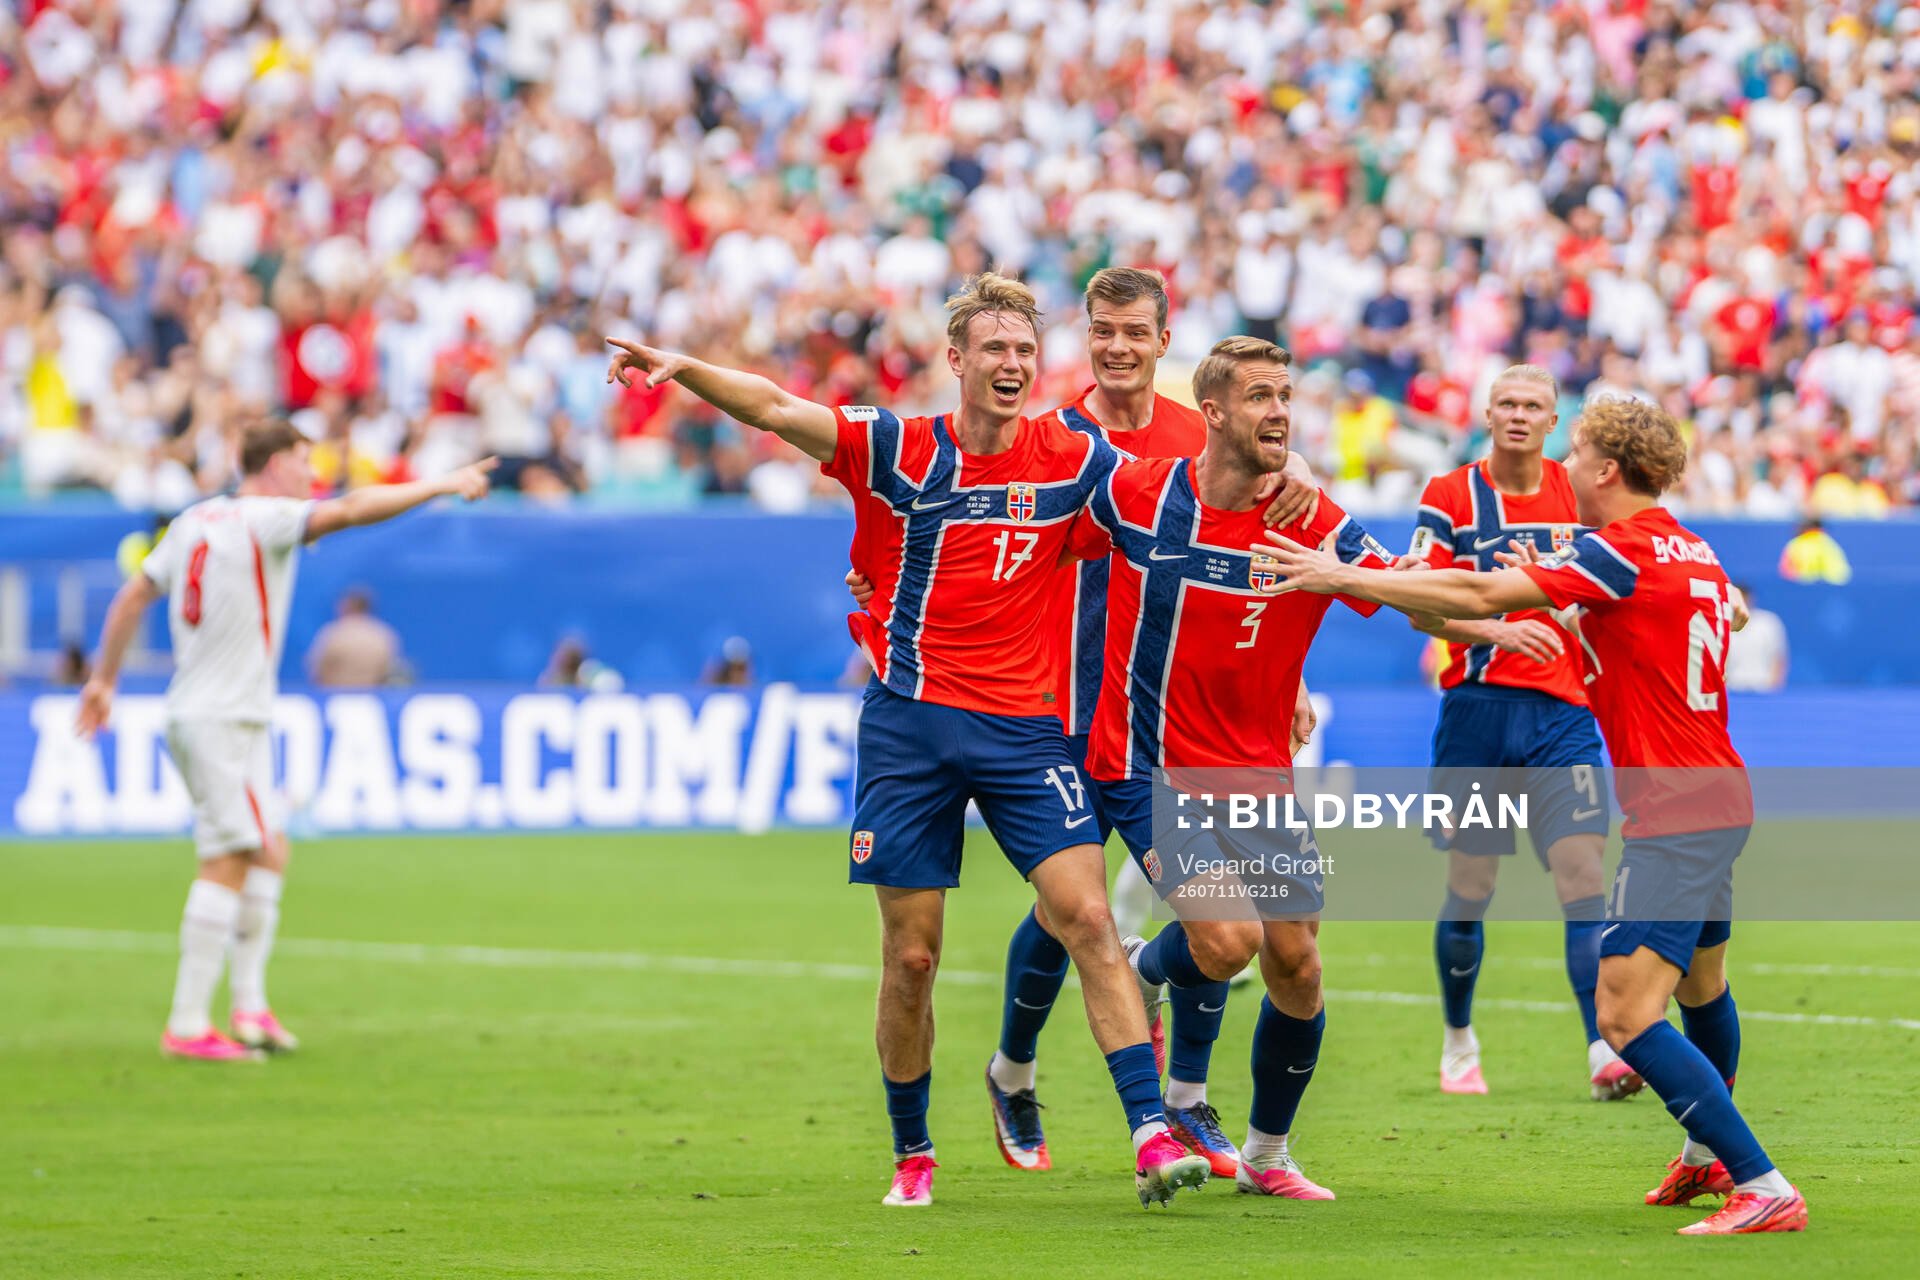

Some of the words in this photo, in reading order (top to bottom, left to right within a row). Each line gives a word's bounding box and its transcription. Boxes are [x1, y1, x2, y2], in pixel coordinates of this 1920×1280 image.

[992, 530, 1039, 581] 17
[1235, 601, 1268, 649] 3
[1043, 765, 1085, 812] 17
[1571, 764, 1598, 806] 9
[1605, 866, 1630, 919] 1
